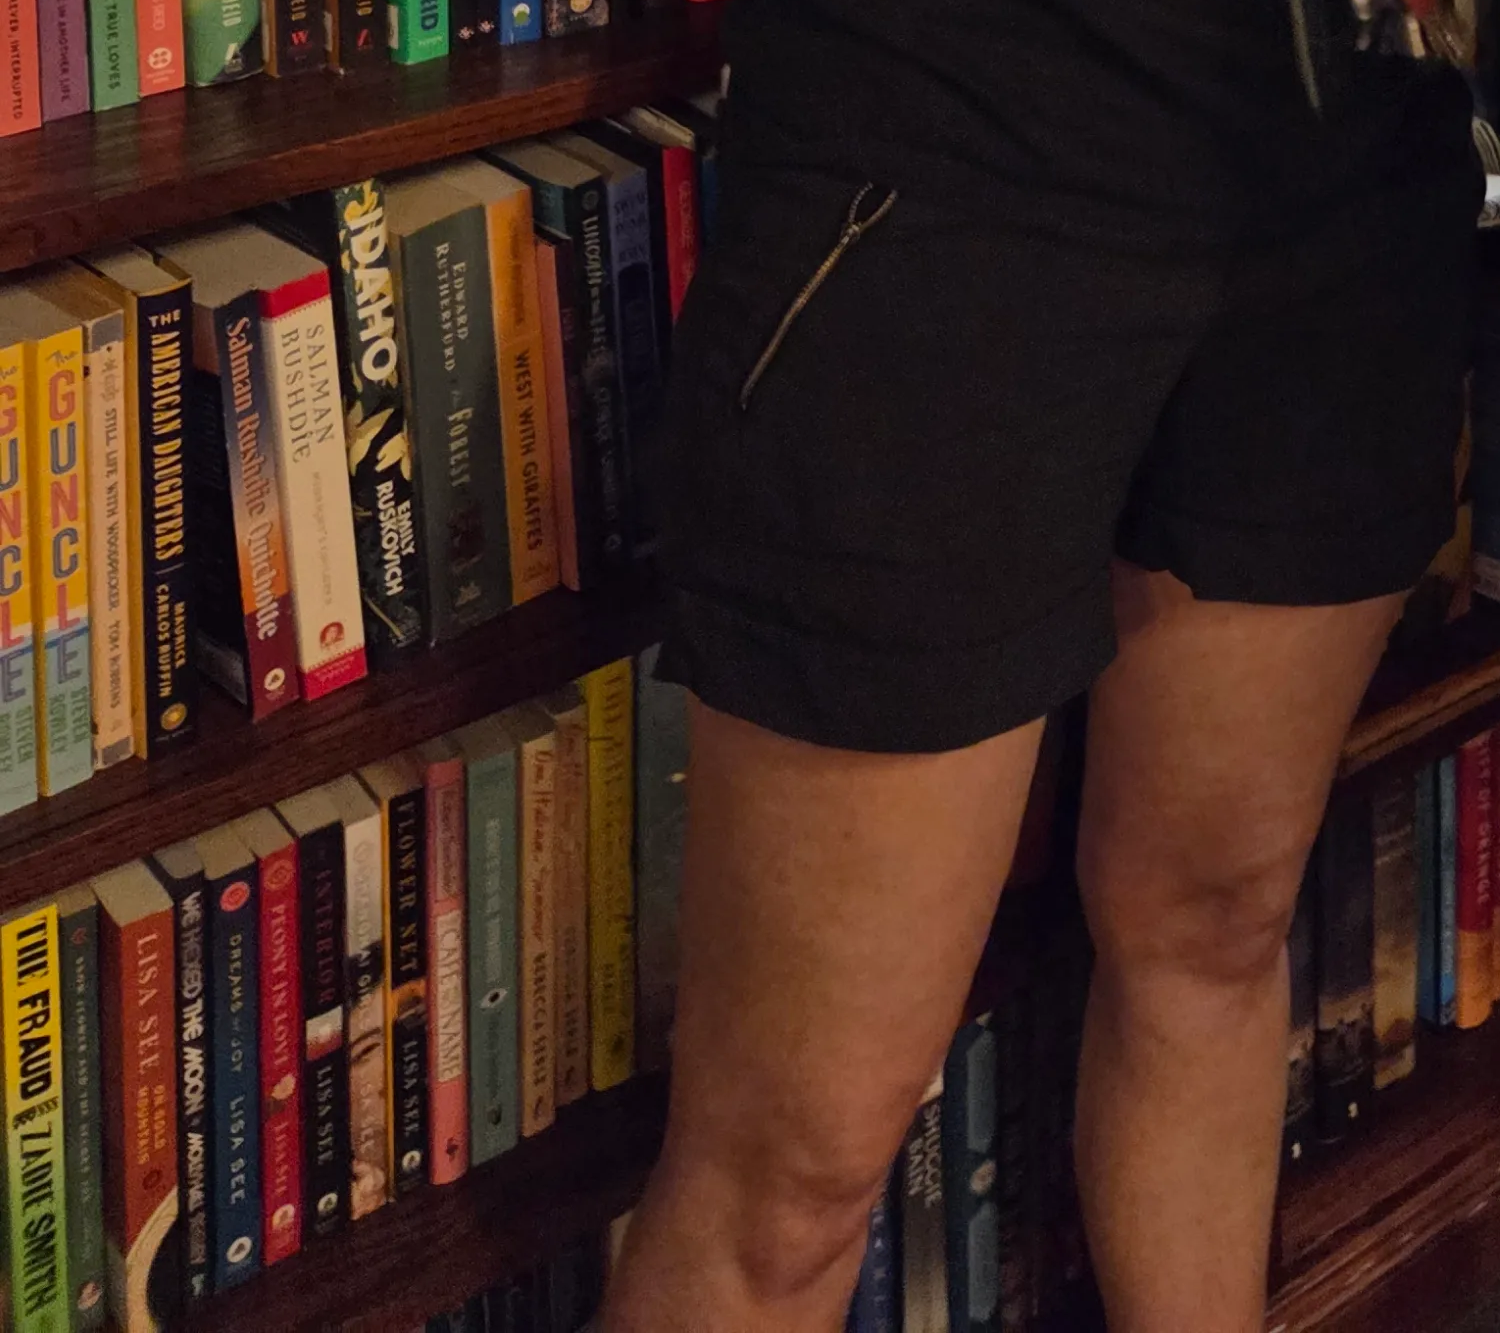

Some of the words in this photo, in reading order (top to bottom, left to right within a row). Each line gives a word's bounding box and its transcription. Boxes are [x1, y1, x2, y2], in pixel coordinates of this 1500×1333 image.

[148, 308, 182, 328] THE
[345, 205, 399, 383] IDAHO
[150, 331, 184, 438] AMERICAN
[305, 323, 336, 446] SALMAN
[513, 345, 532, 403] WEST
[517, 405, 536, 459] WITH
[154, 442, 185, 562] DAUGHTERS
[375, 479, 405, 597] RUSKOVICH
[395, 499, 416, 556] EMILY
[521, 462, 544, 553] GIRAFFES
[15, 914, 50, 987] THE
[136, 933, 159, 1007] LISA
[16, 992, 53, 1102] FRAUD
[138, 1016, 162, 1076] SEE
[183, 1044, 206, 1115] MOON
